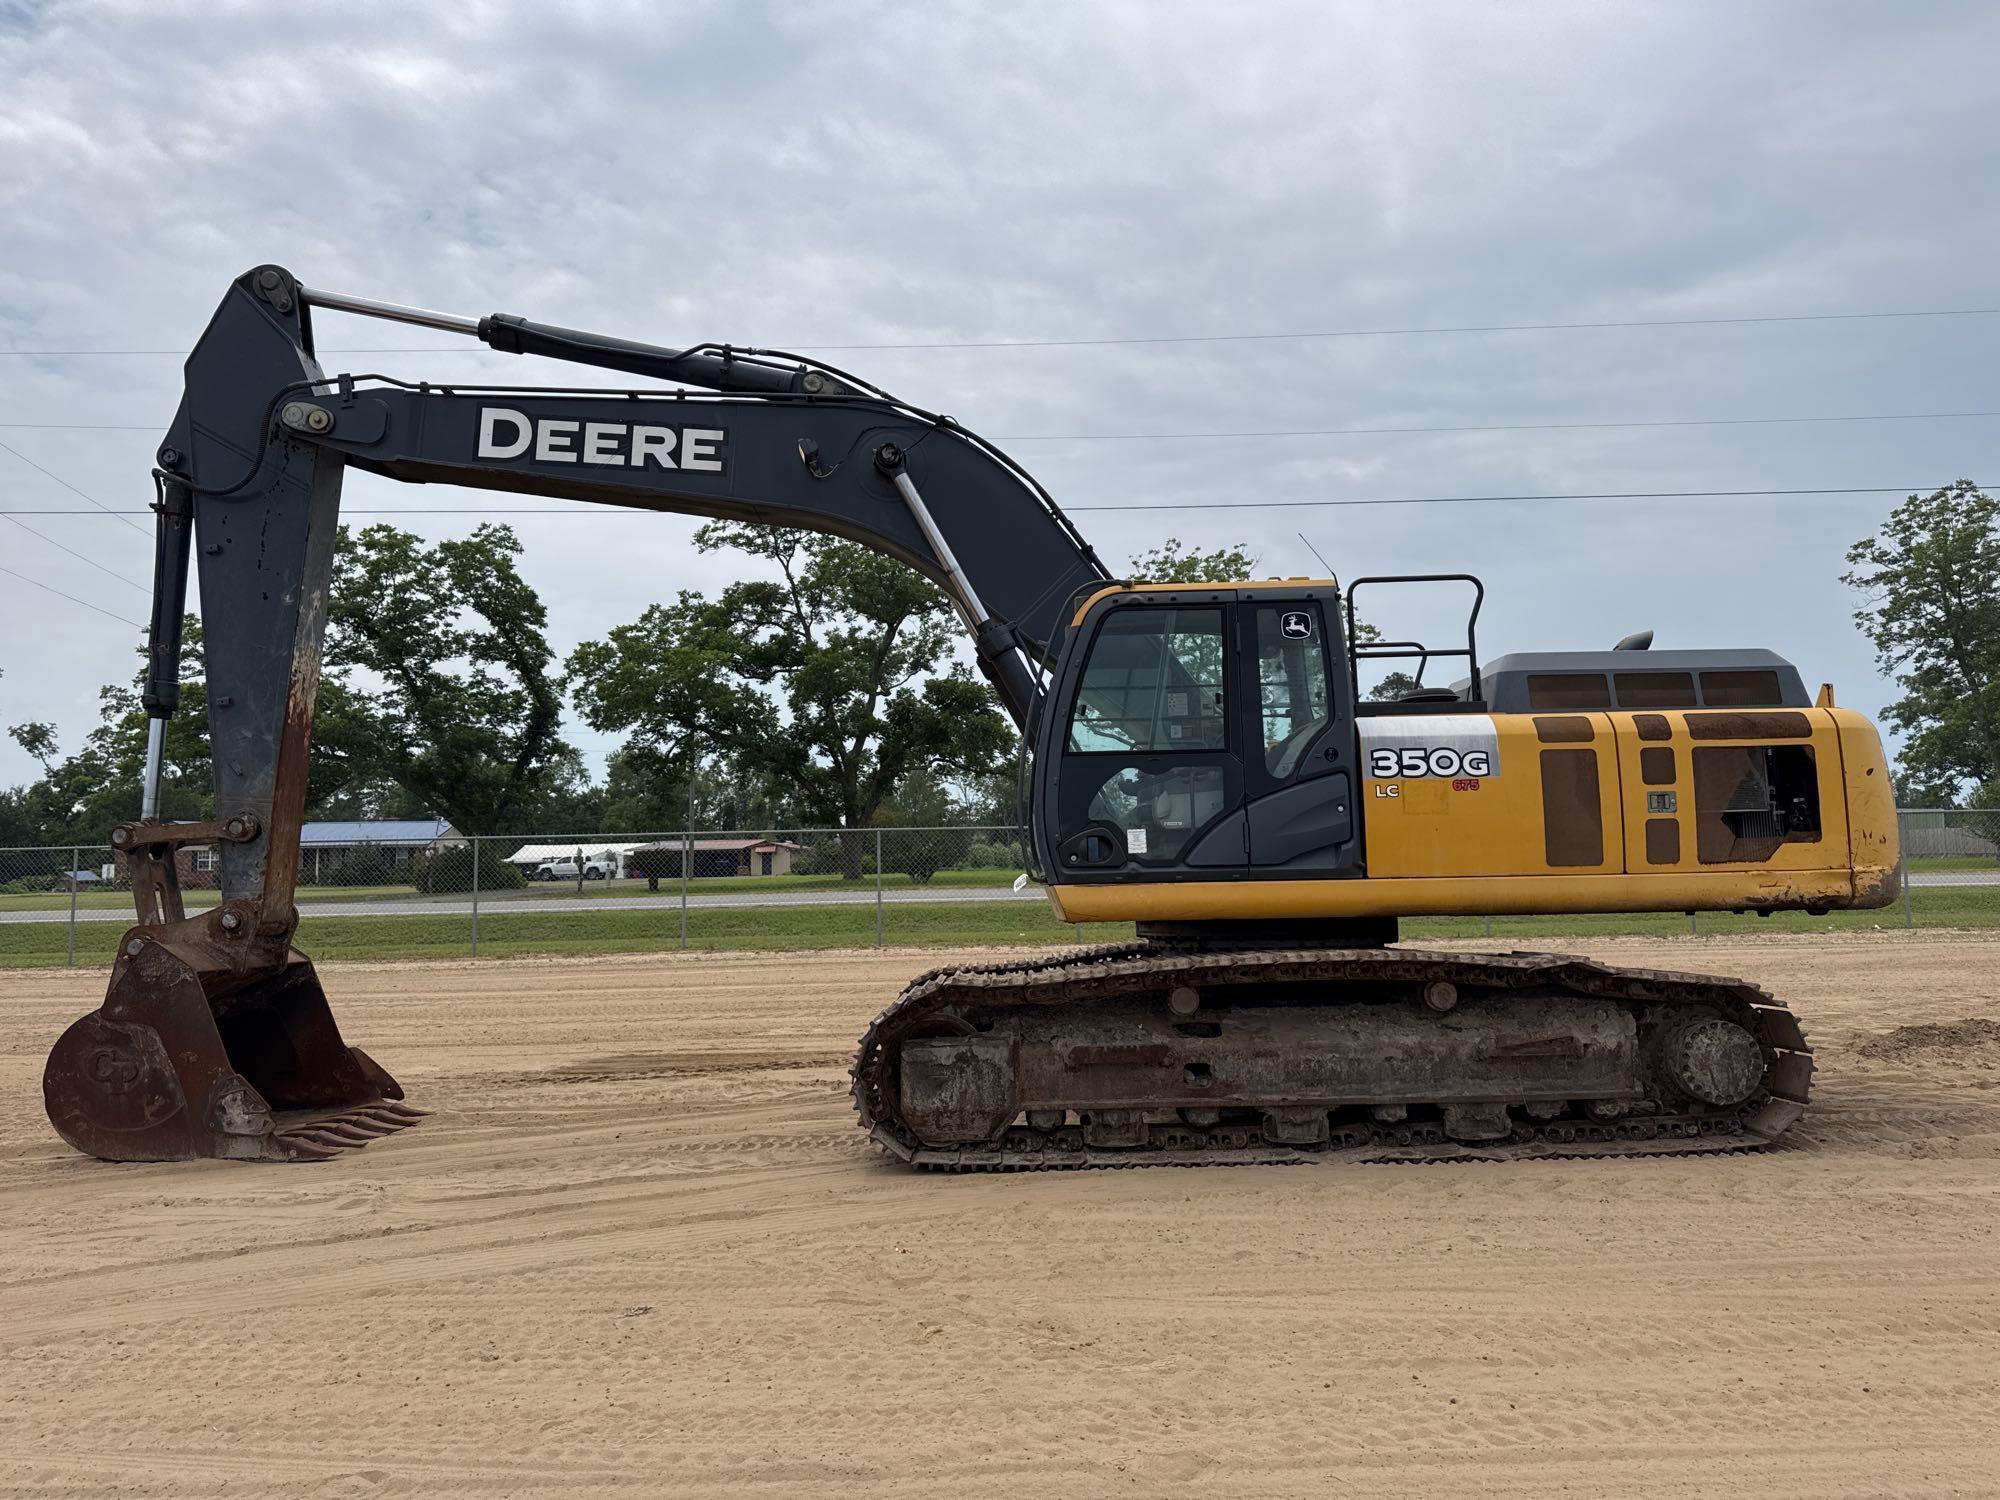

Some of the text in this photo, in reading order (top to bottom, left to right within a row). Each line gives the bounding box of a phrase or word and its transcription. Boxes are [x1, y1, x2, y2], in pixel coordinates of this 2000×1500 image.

[477, 406, 725, 472] DEERE
[1371, 747, 1490, 778] 350G
[1375, 784, 1399, 798] LC
[1452, 779, 1480, 791] 675
